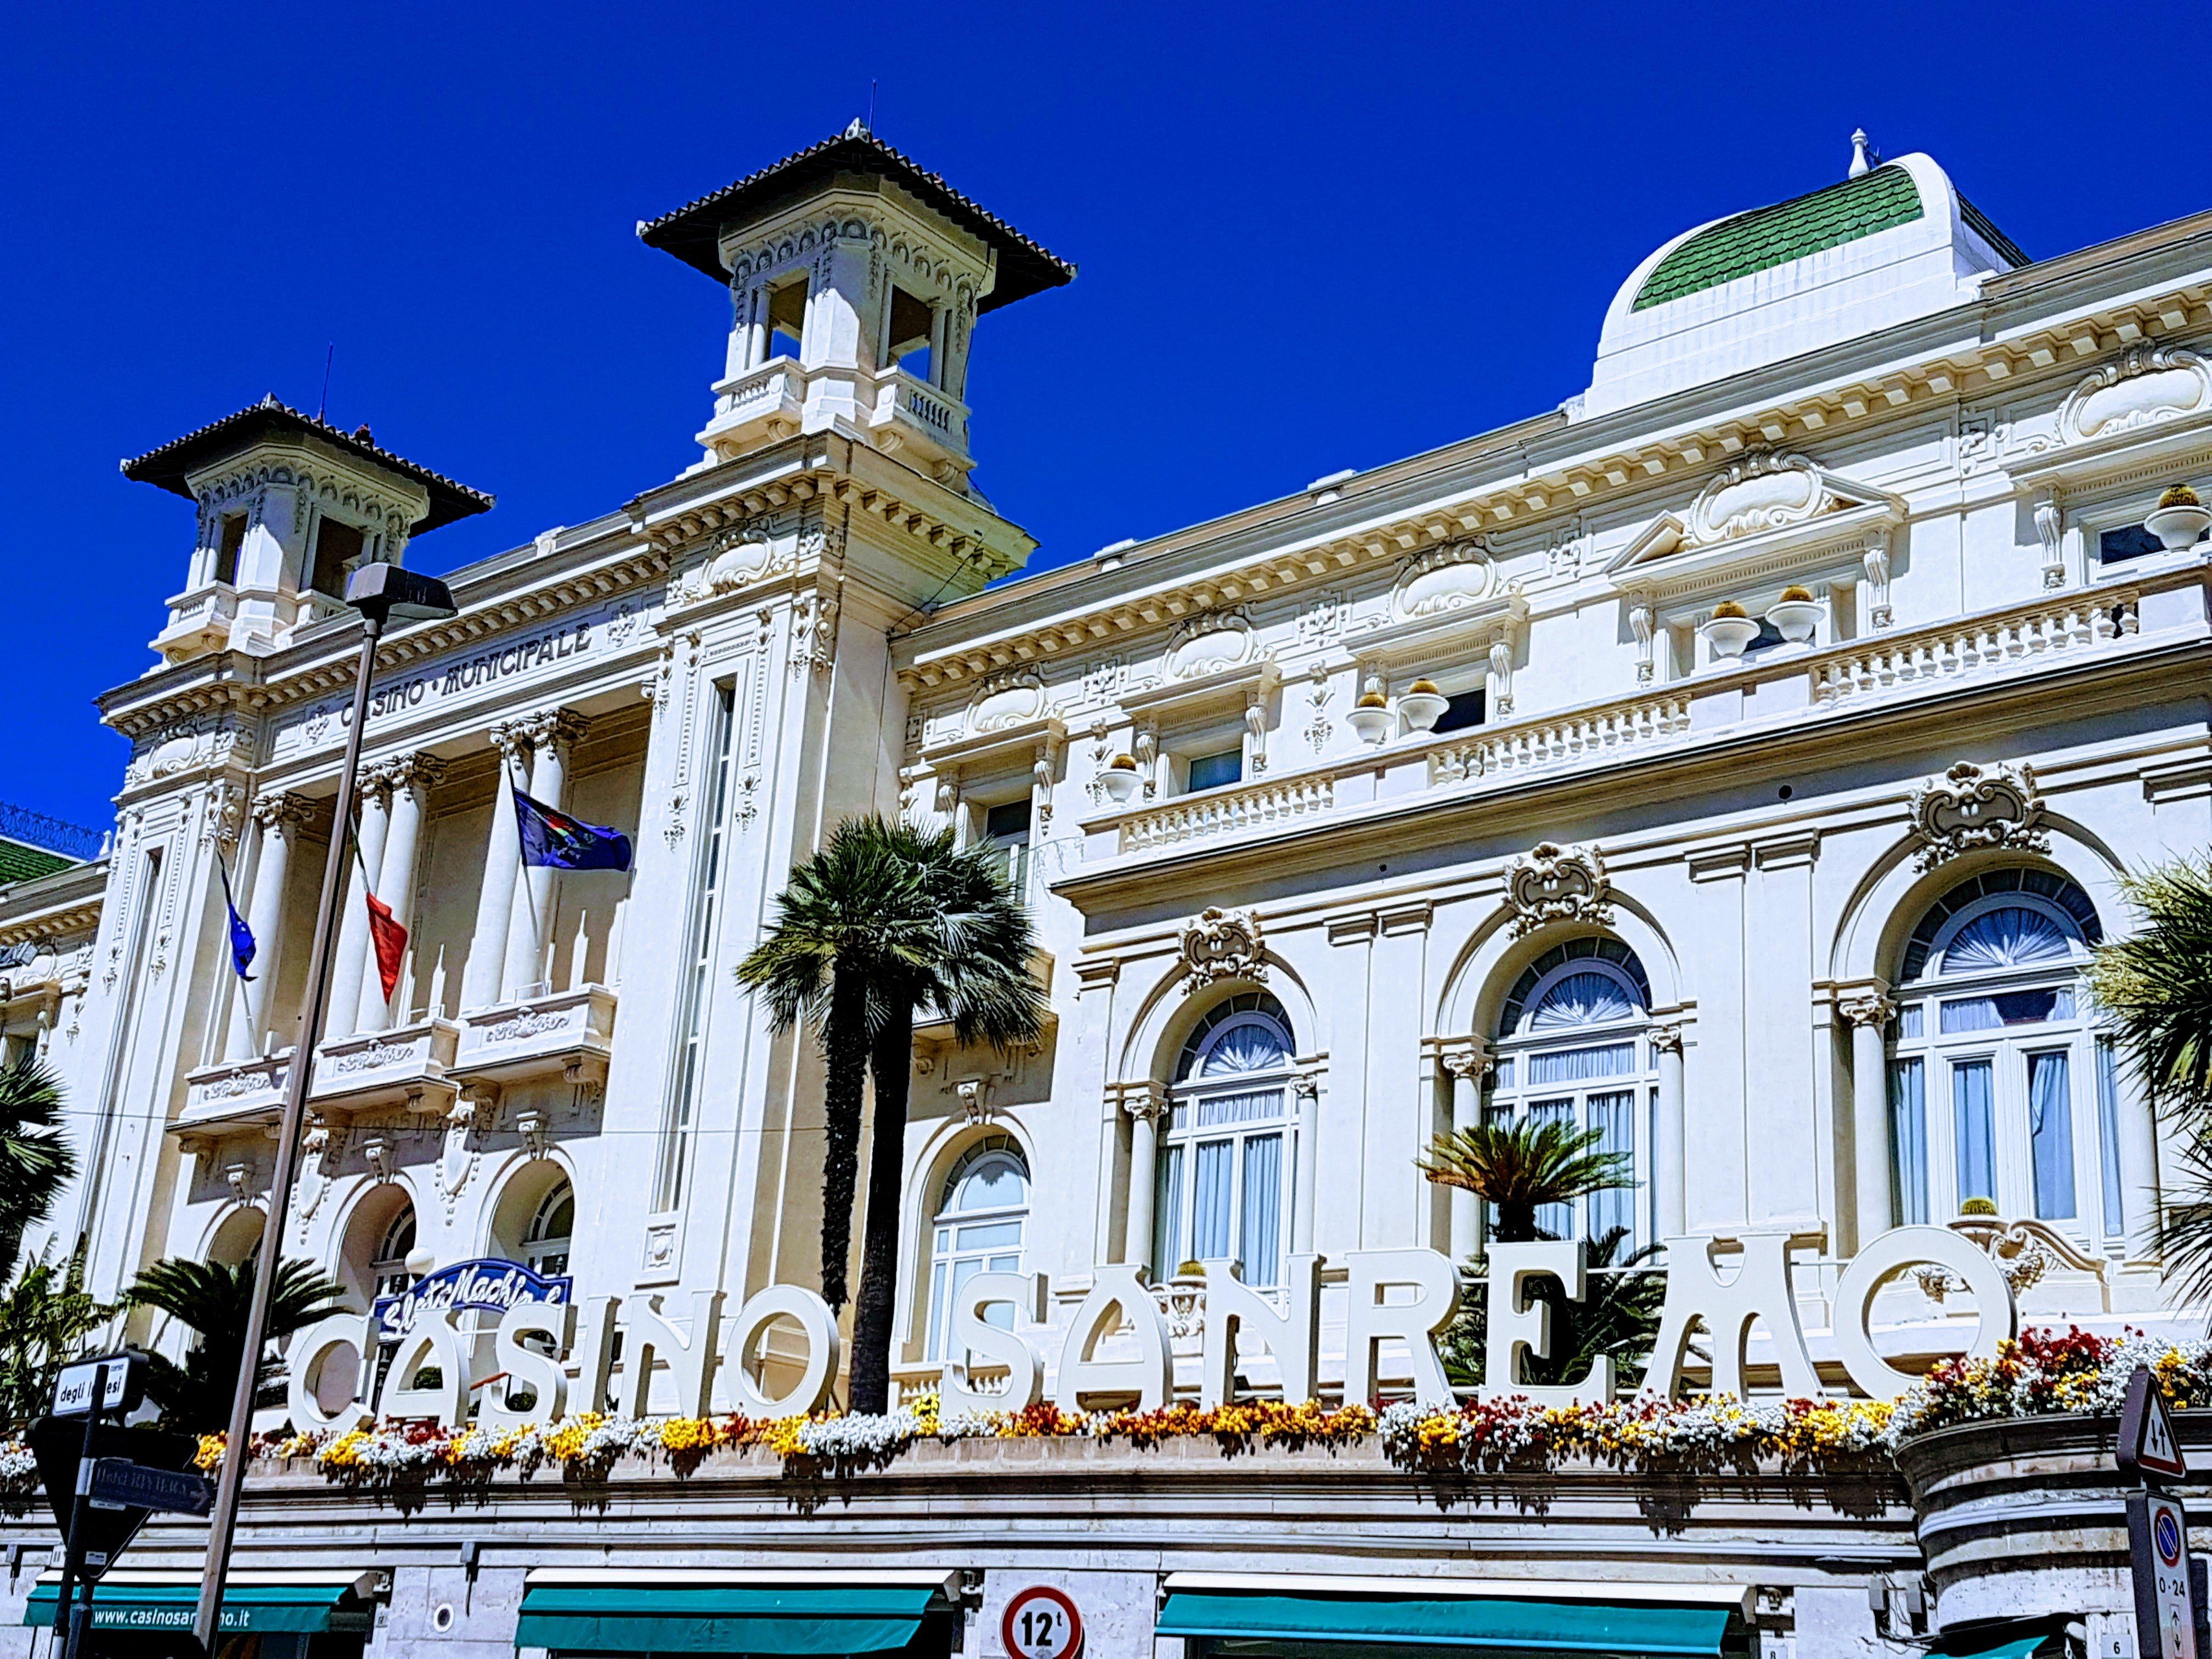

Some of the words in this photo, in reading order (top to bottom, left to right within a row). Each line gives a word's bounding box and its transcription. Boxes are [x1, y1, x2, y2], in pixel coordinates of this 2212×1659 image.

[341, 678, 425, 727] CSINO
[441, 622, 592, 697] MUNICIPALE
[289, 1285, 838, 1428] CASINO
[938, 1225, 2017, 1422] SANREMO
[60, 1381, 85, 1403] degli
[2113, 1641, 2120, 1654] 6
